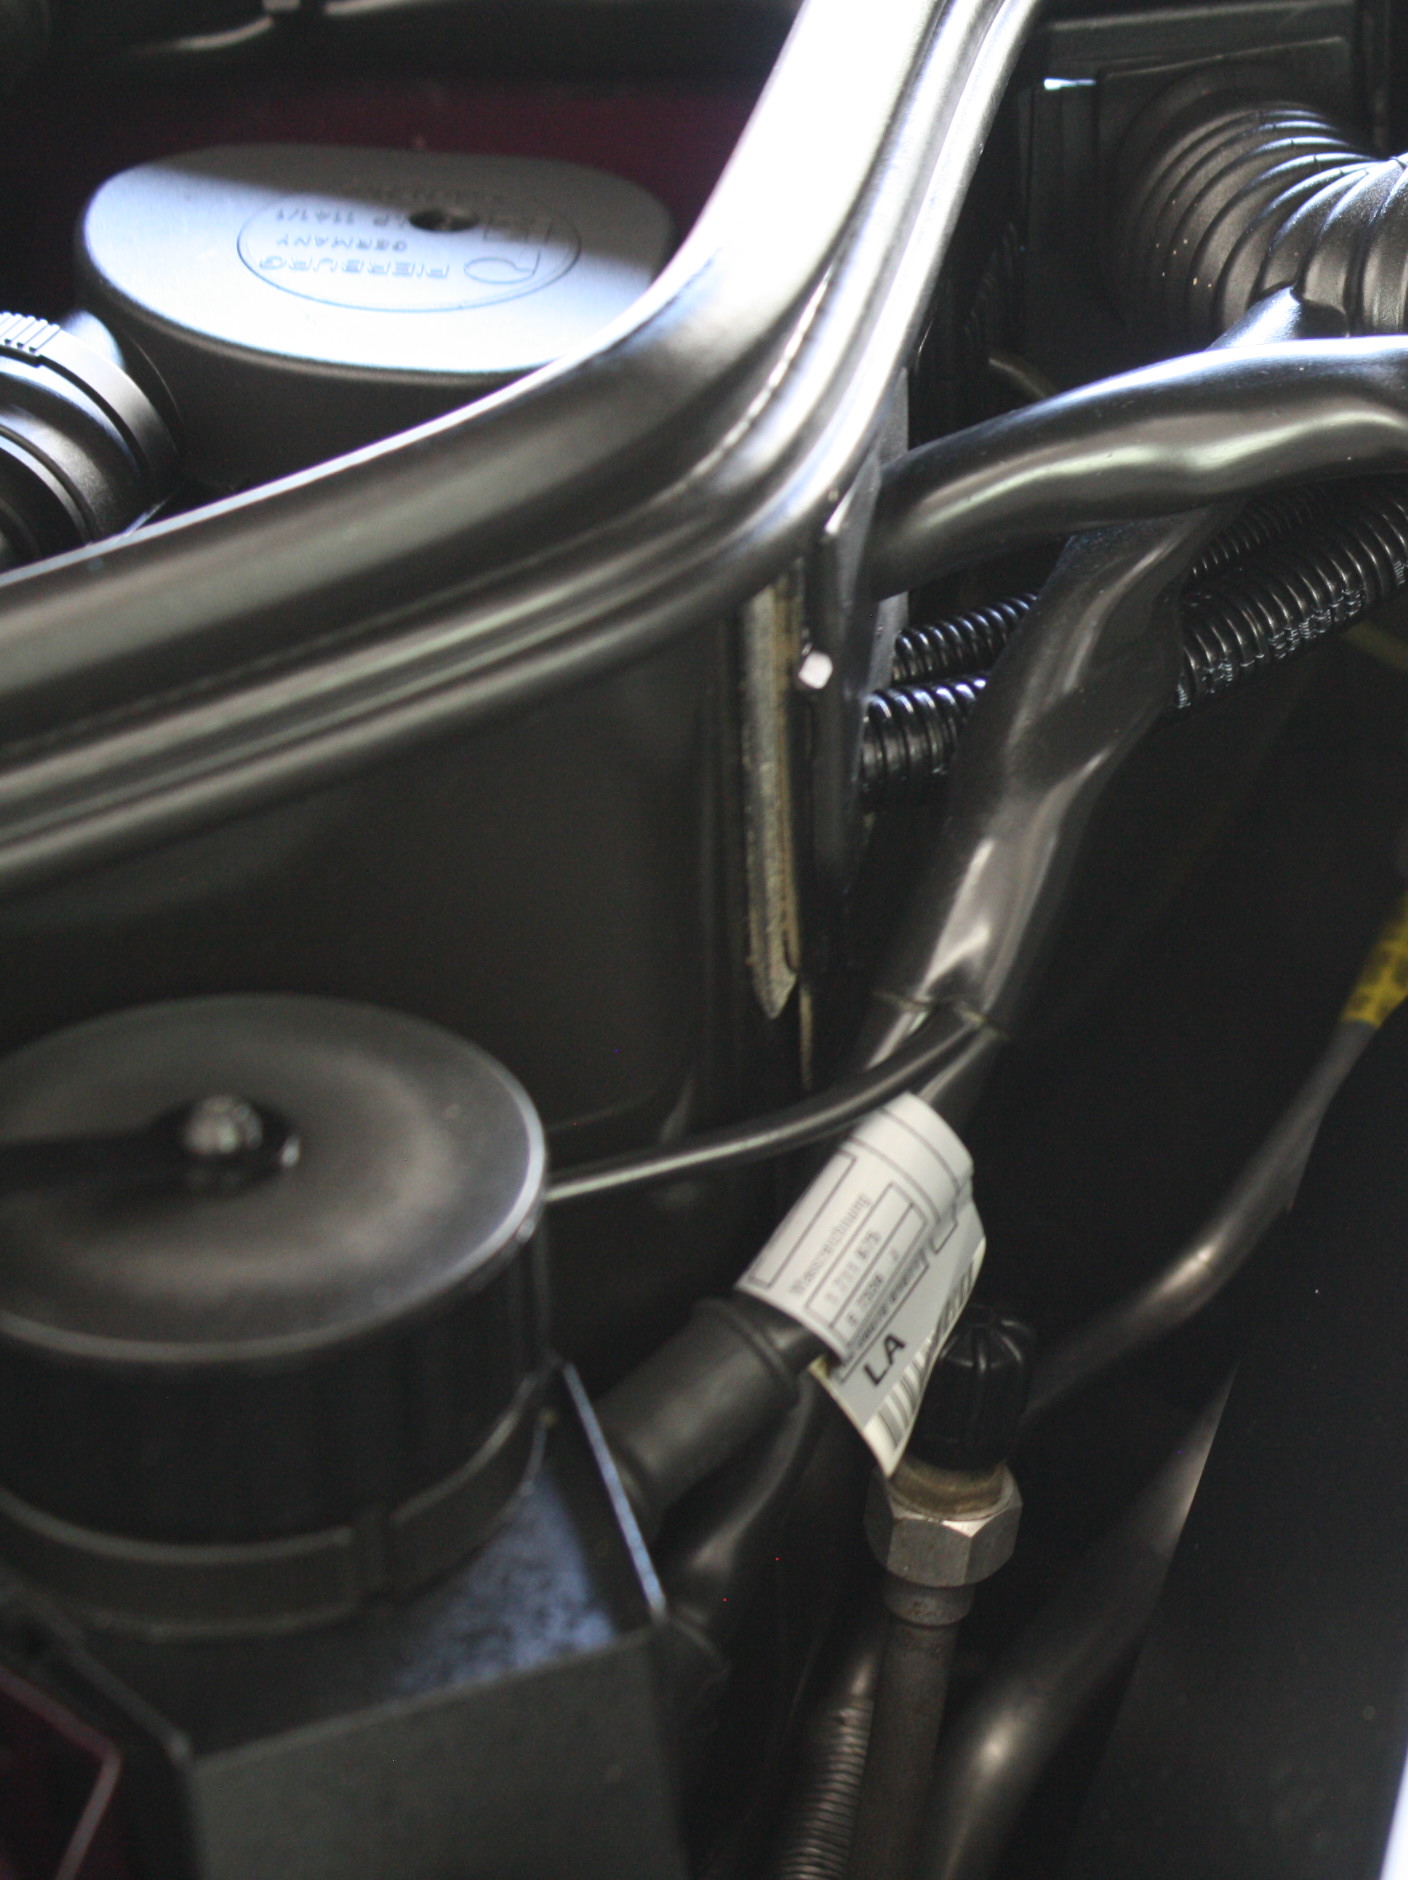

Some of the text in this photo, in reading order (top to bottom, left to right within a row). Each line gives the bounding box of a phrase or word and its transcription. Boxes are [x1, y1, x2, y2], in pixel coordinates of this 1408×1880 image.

[277, 232, 408, 252] GERMANY
[259, 255, 449, 279] PIERBURG
[864, 1335, 905, 1386] LA
